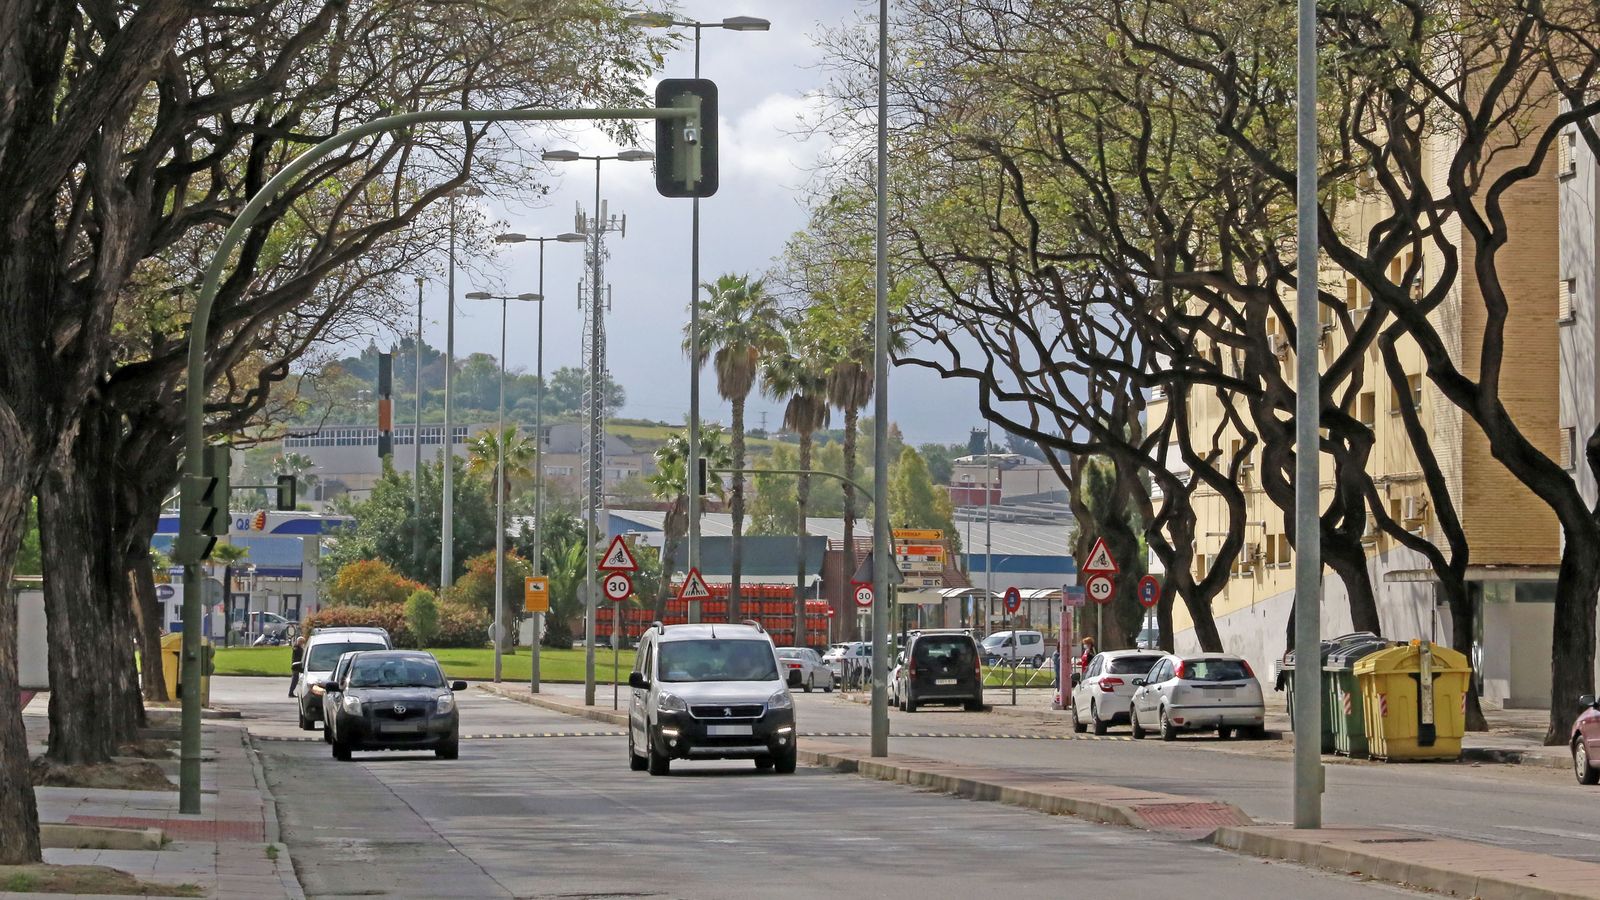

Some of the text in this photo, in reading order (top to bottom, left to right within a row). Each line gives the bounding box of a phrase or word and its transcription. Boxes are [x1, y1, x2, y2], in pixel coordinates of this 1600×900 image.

[236, 518, 250, 531] Q8
[609, 581, 627, 592] 30
[1092, 583, 1109, 593] 30
[858, 592, 871, 600] 30
